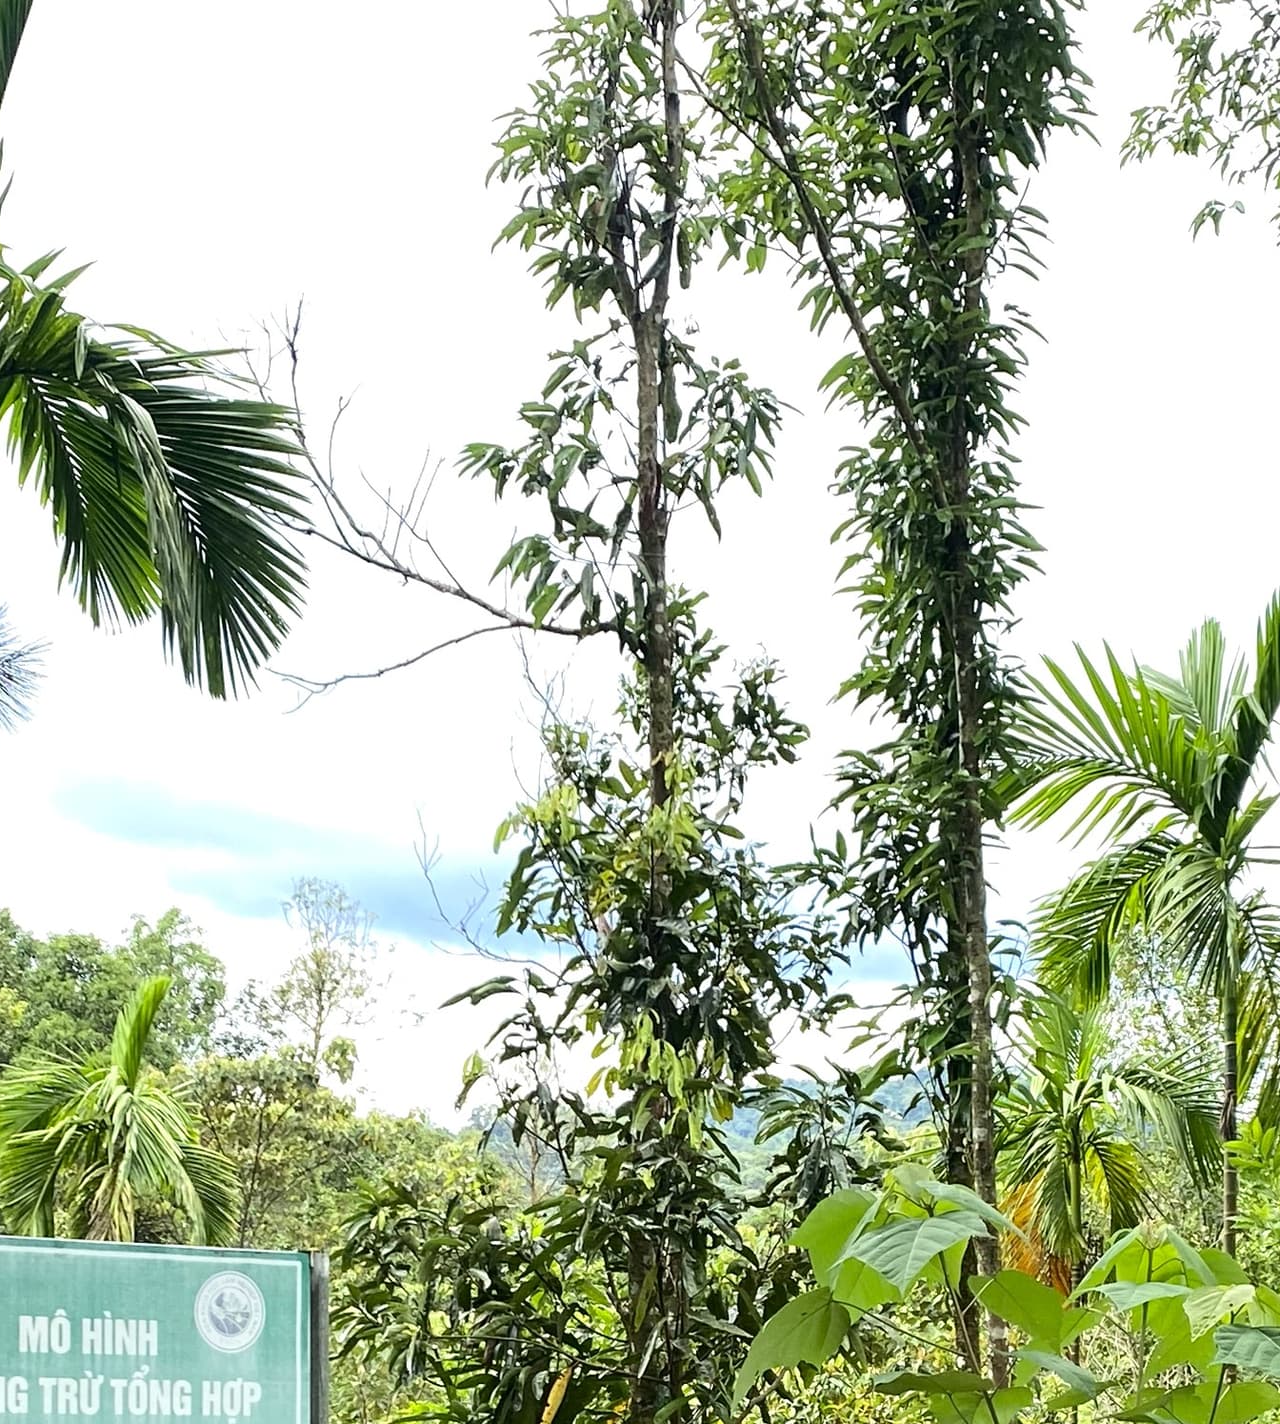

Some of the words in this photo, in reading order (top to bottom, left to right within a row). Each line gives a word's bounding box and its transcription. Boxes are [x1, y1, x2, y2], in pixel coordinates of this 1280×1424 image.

[19, 1309, 72, 1354] MÔ
[82, 1310, 158, 1356] HÌNH
[39, 1370, 104, 1416] TRỪ
[111, 1365, 192, 1416] TỔNG
[202, 1378, 262, 1424] HỢP
